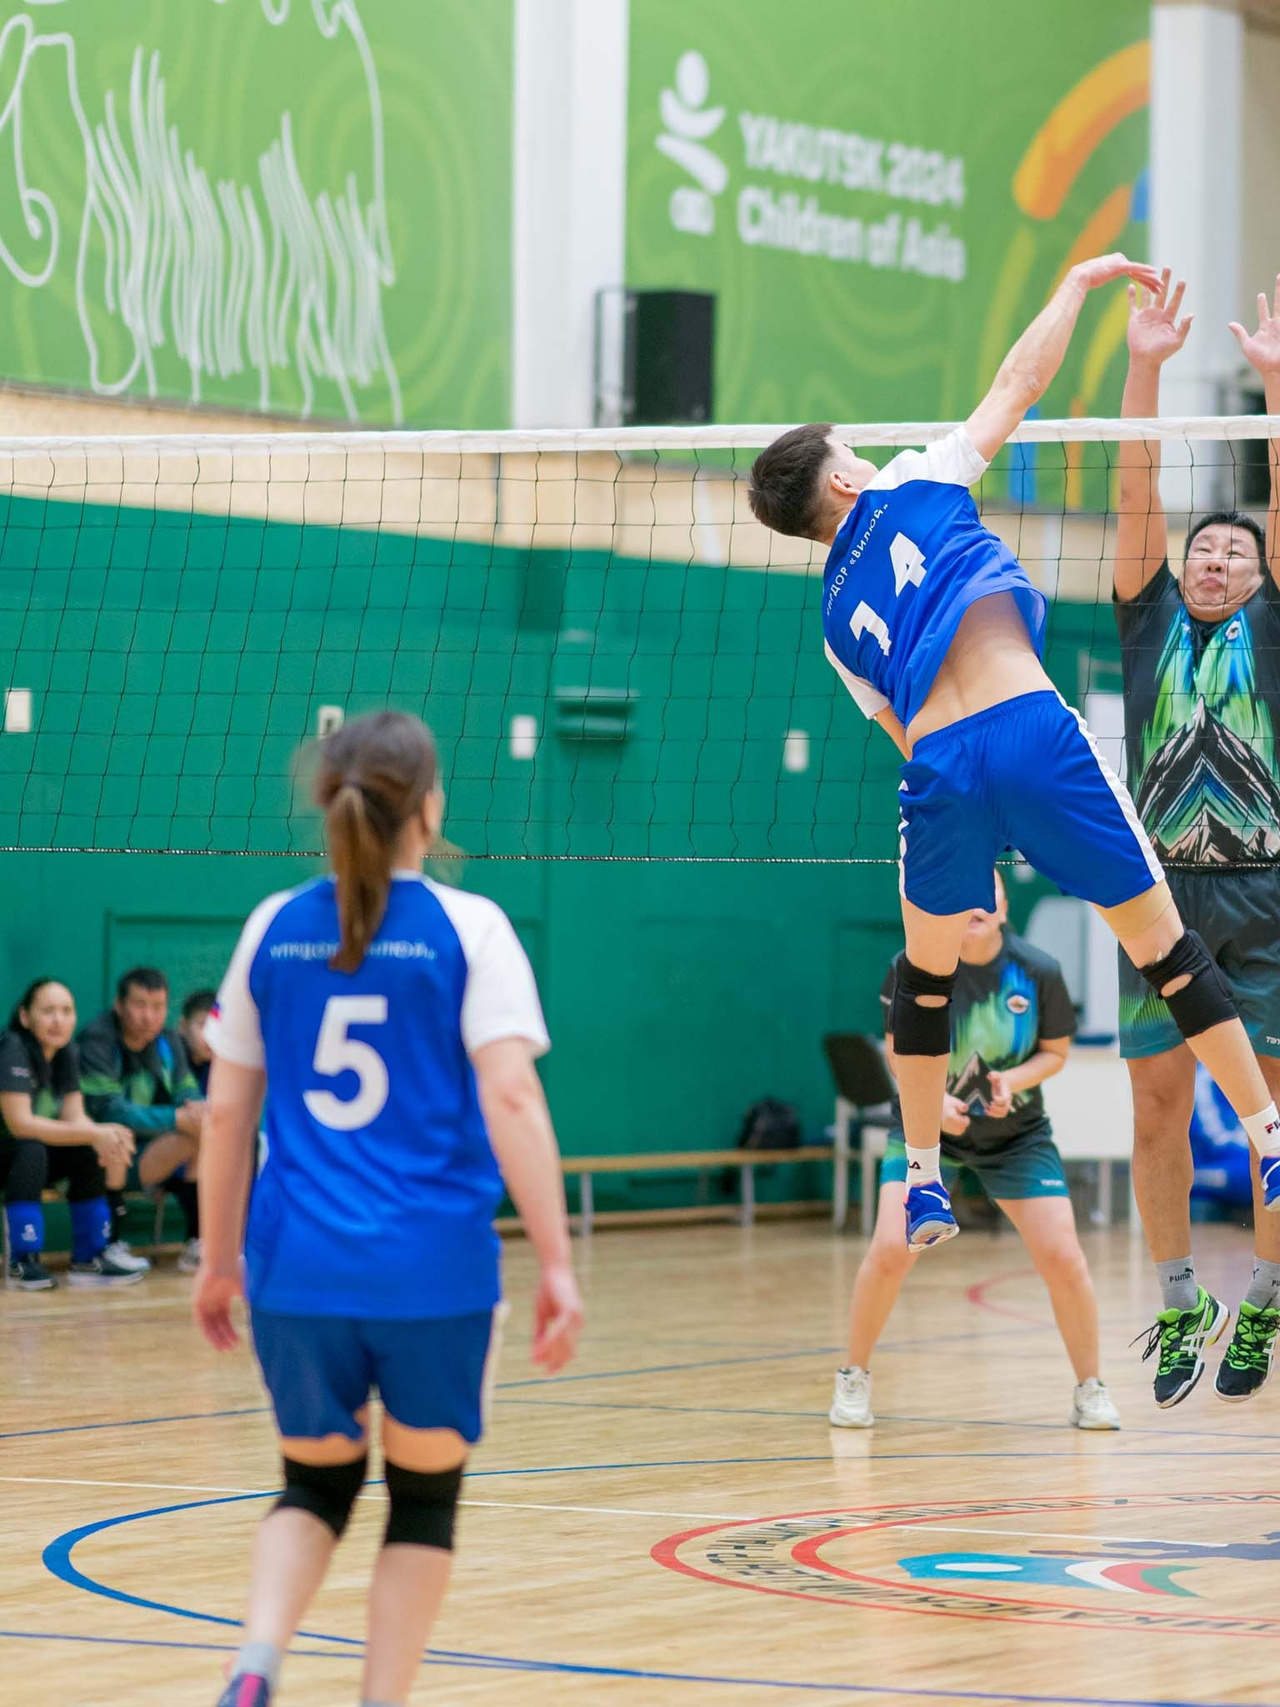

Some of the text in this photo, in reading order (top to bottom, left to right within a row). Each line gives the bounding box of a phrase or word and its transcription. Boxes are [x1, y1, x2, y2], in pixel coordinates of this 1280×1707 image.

[738, 110, 965, 208] YAKUTSK 2024
[738, 185, 966, 284] Children of Asia
[302, 994, 389, 1131] 5
